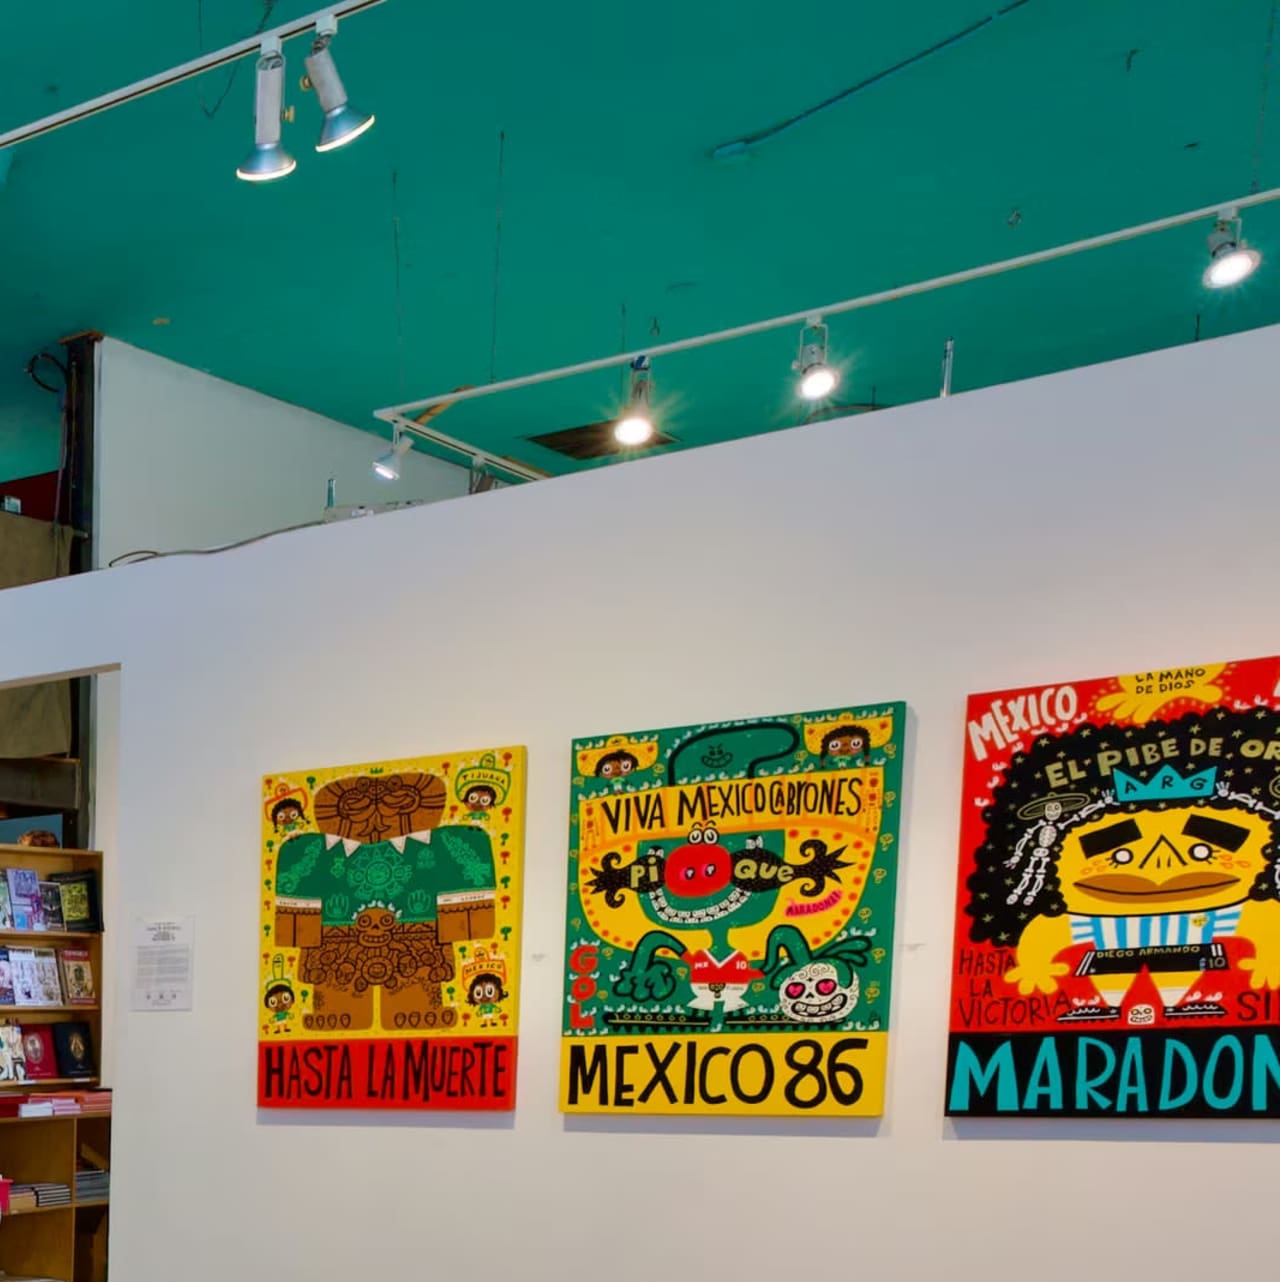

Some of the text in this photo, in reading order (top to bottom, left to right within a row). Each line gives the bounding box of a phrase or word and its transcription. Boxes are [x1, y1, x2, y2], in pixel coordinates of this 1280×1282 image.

[1135, 668, 1206, 682] LA MANO
[1136, 680, 1195, 694] DE DIOS
[968, 686, 1077, 762] MEXICO
[1045, 757, 1085, 788] EL
[1097, 738, 1180, 776] PIBE
[1190, 737, 1224, 756] DE
[601, 792, 665, 834] VIVA
[677, 783, 766, 826] MEXICO
[959, 949, 1017, 975] HASTA
[1096, 946, 1200, 958] DIEGO ARMANDO
[1209, 957, 1226, 968] 10
[736, 961, 748, 970] 10
[970, 979, 993, 998] LA
[958, 991, 1072, 1028] VICTORIA
[264, 1039, 508, 1101] HASTA LA MUERTE
[569, 1038, 870, 1109] MEXICO 86
